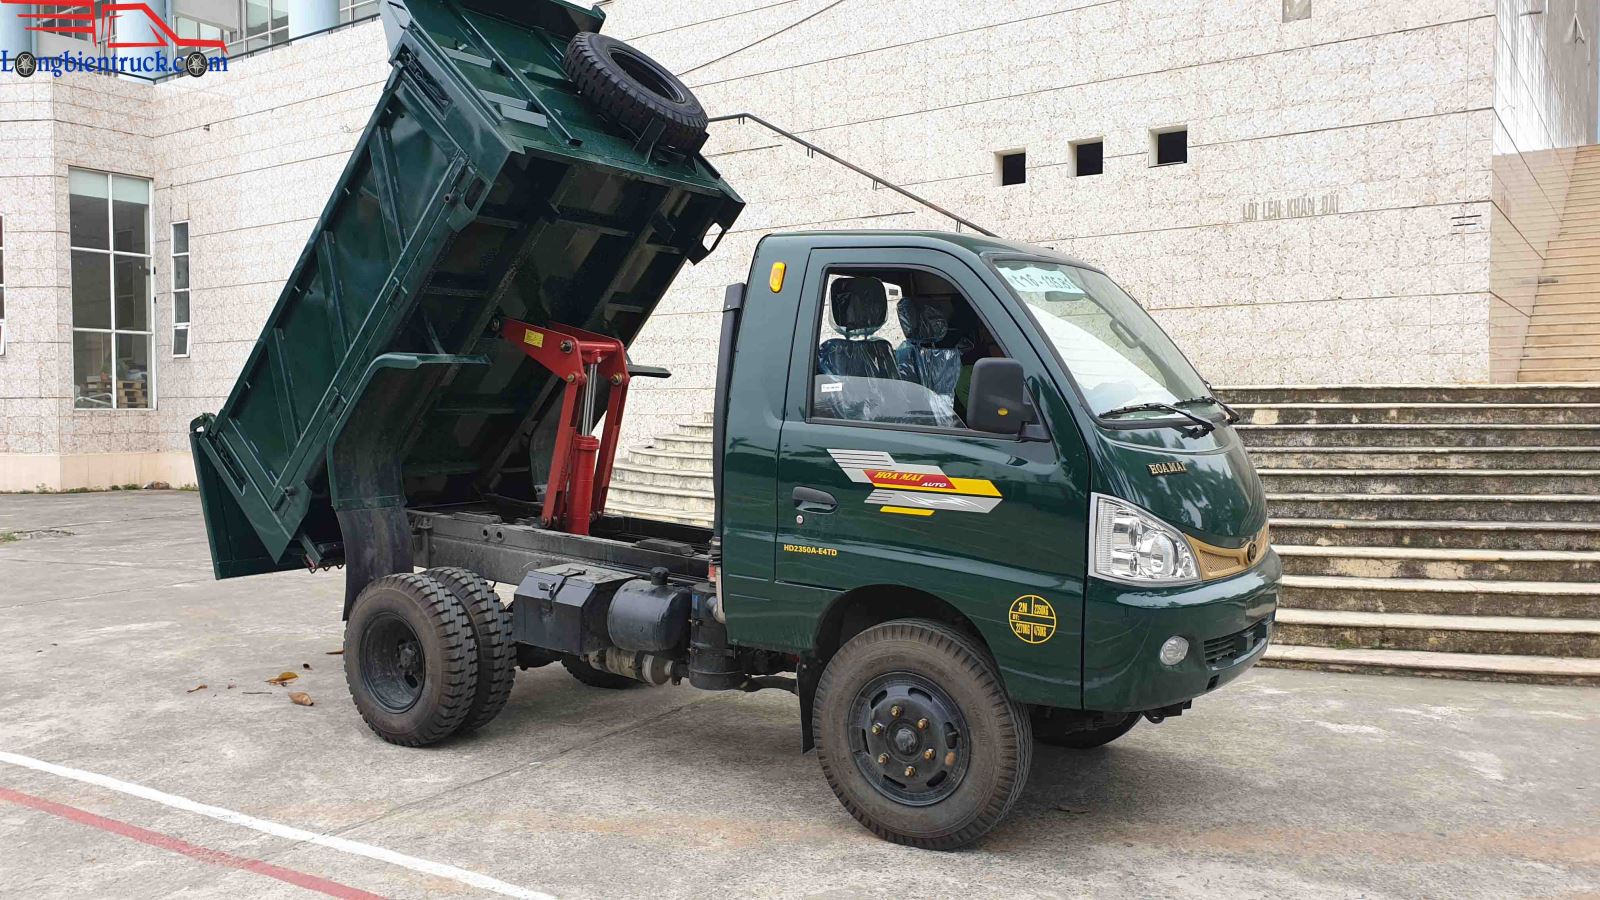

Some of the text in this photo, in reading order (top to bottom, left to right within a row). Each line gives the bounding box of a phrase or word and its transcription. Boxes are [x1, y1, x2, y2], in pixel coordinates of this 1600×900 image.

[874, 471, 925, 482] HOA MAI
[783, 544, 838, 556] HD2350A-E4TD
[1018, 601, 1028, 613] 2N
